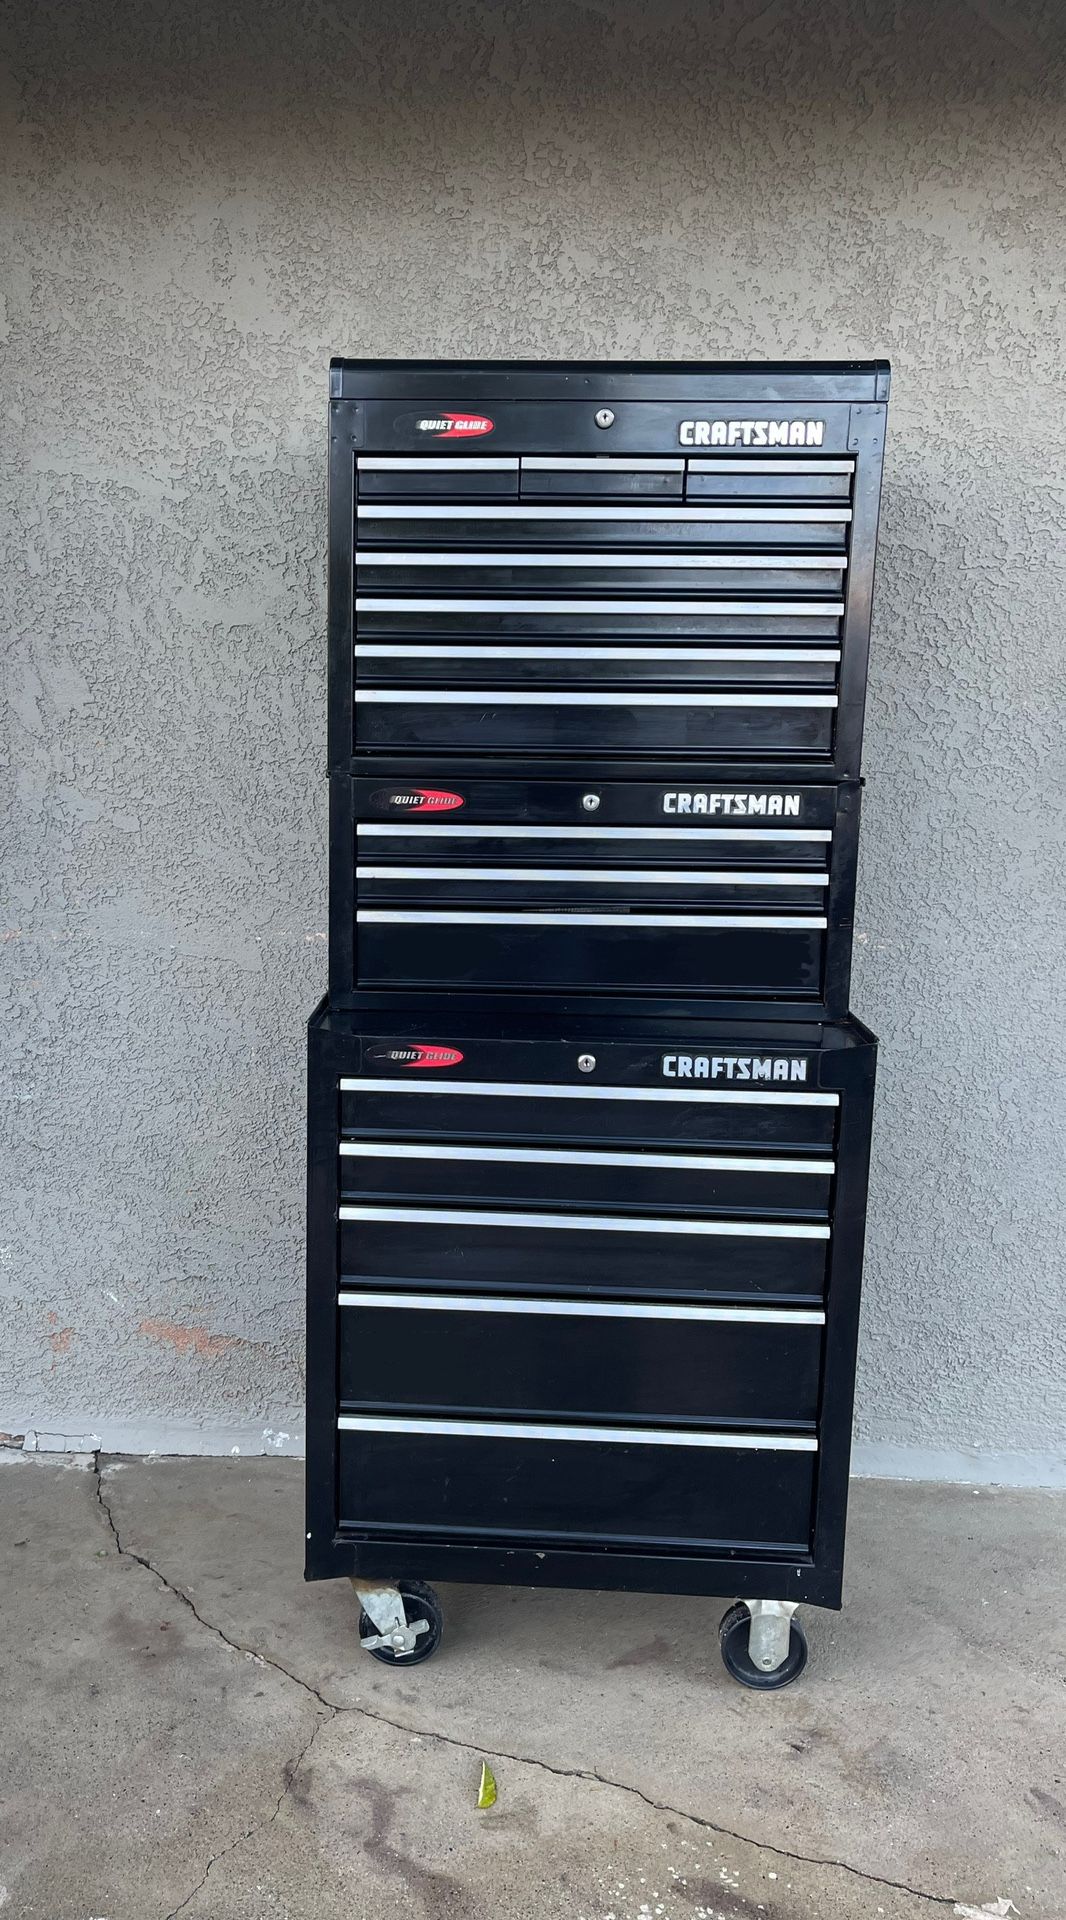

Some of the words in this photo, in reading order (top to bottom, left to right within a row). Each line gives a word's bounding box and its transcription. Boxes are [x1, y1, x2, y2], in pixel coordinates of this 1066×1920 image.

[419, 419, 454, 431] QUIET
[454, 420, 488, 431] GLIDE
[679, 420, 824, 446] CRAFTSMAN
[394, 795, 425, 805] QUIET
[663, 793, 800, 816] CRAFTSMAN
[390, 1050, 423, 1060] QUIET
[425, 1051, 456, 1060] GLIDE
[662, 1056, 807, 1081] CRAFTSMAN
